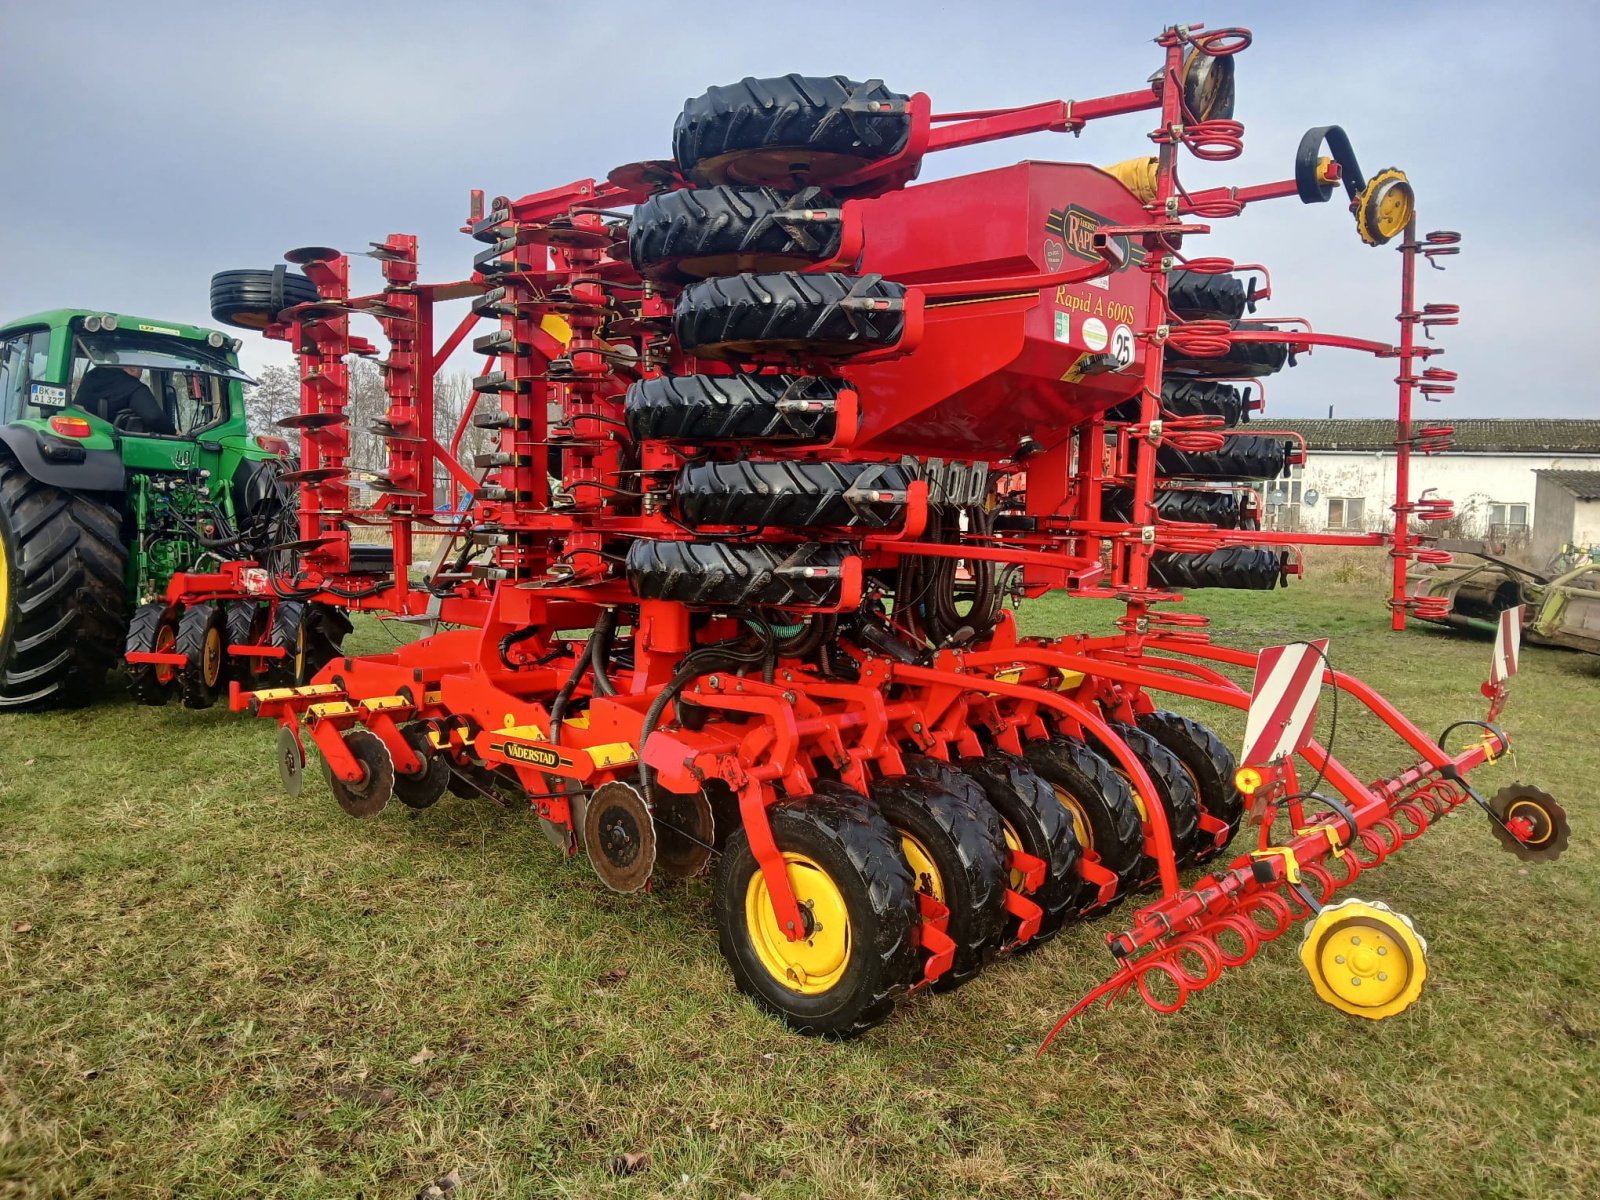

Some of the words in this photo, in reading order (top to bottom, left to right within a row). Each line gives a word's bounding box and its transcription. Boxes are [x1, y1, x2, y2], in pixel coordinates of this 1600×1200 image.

[1069, 215, 1098, 254] RAPI
[1055, 285, 1092, 312] Rapid
[1093, 296, 1104, 317] A
[1107, 301, 1134, 324] 600S
[1116, 334, 1130, 366] 25
[46, 396, 65, 405] 327
[508, 744, 555, 765] VÄDERSTAD
